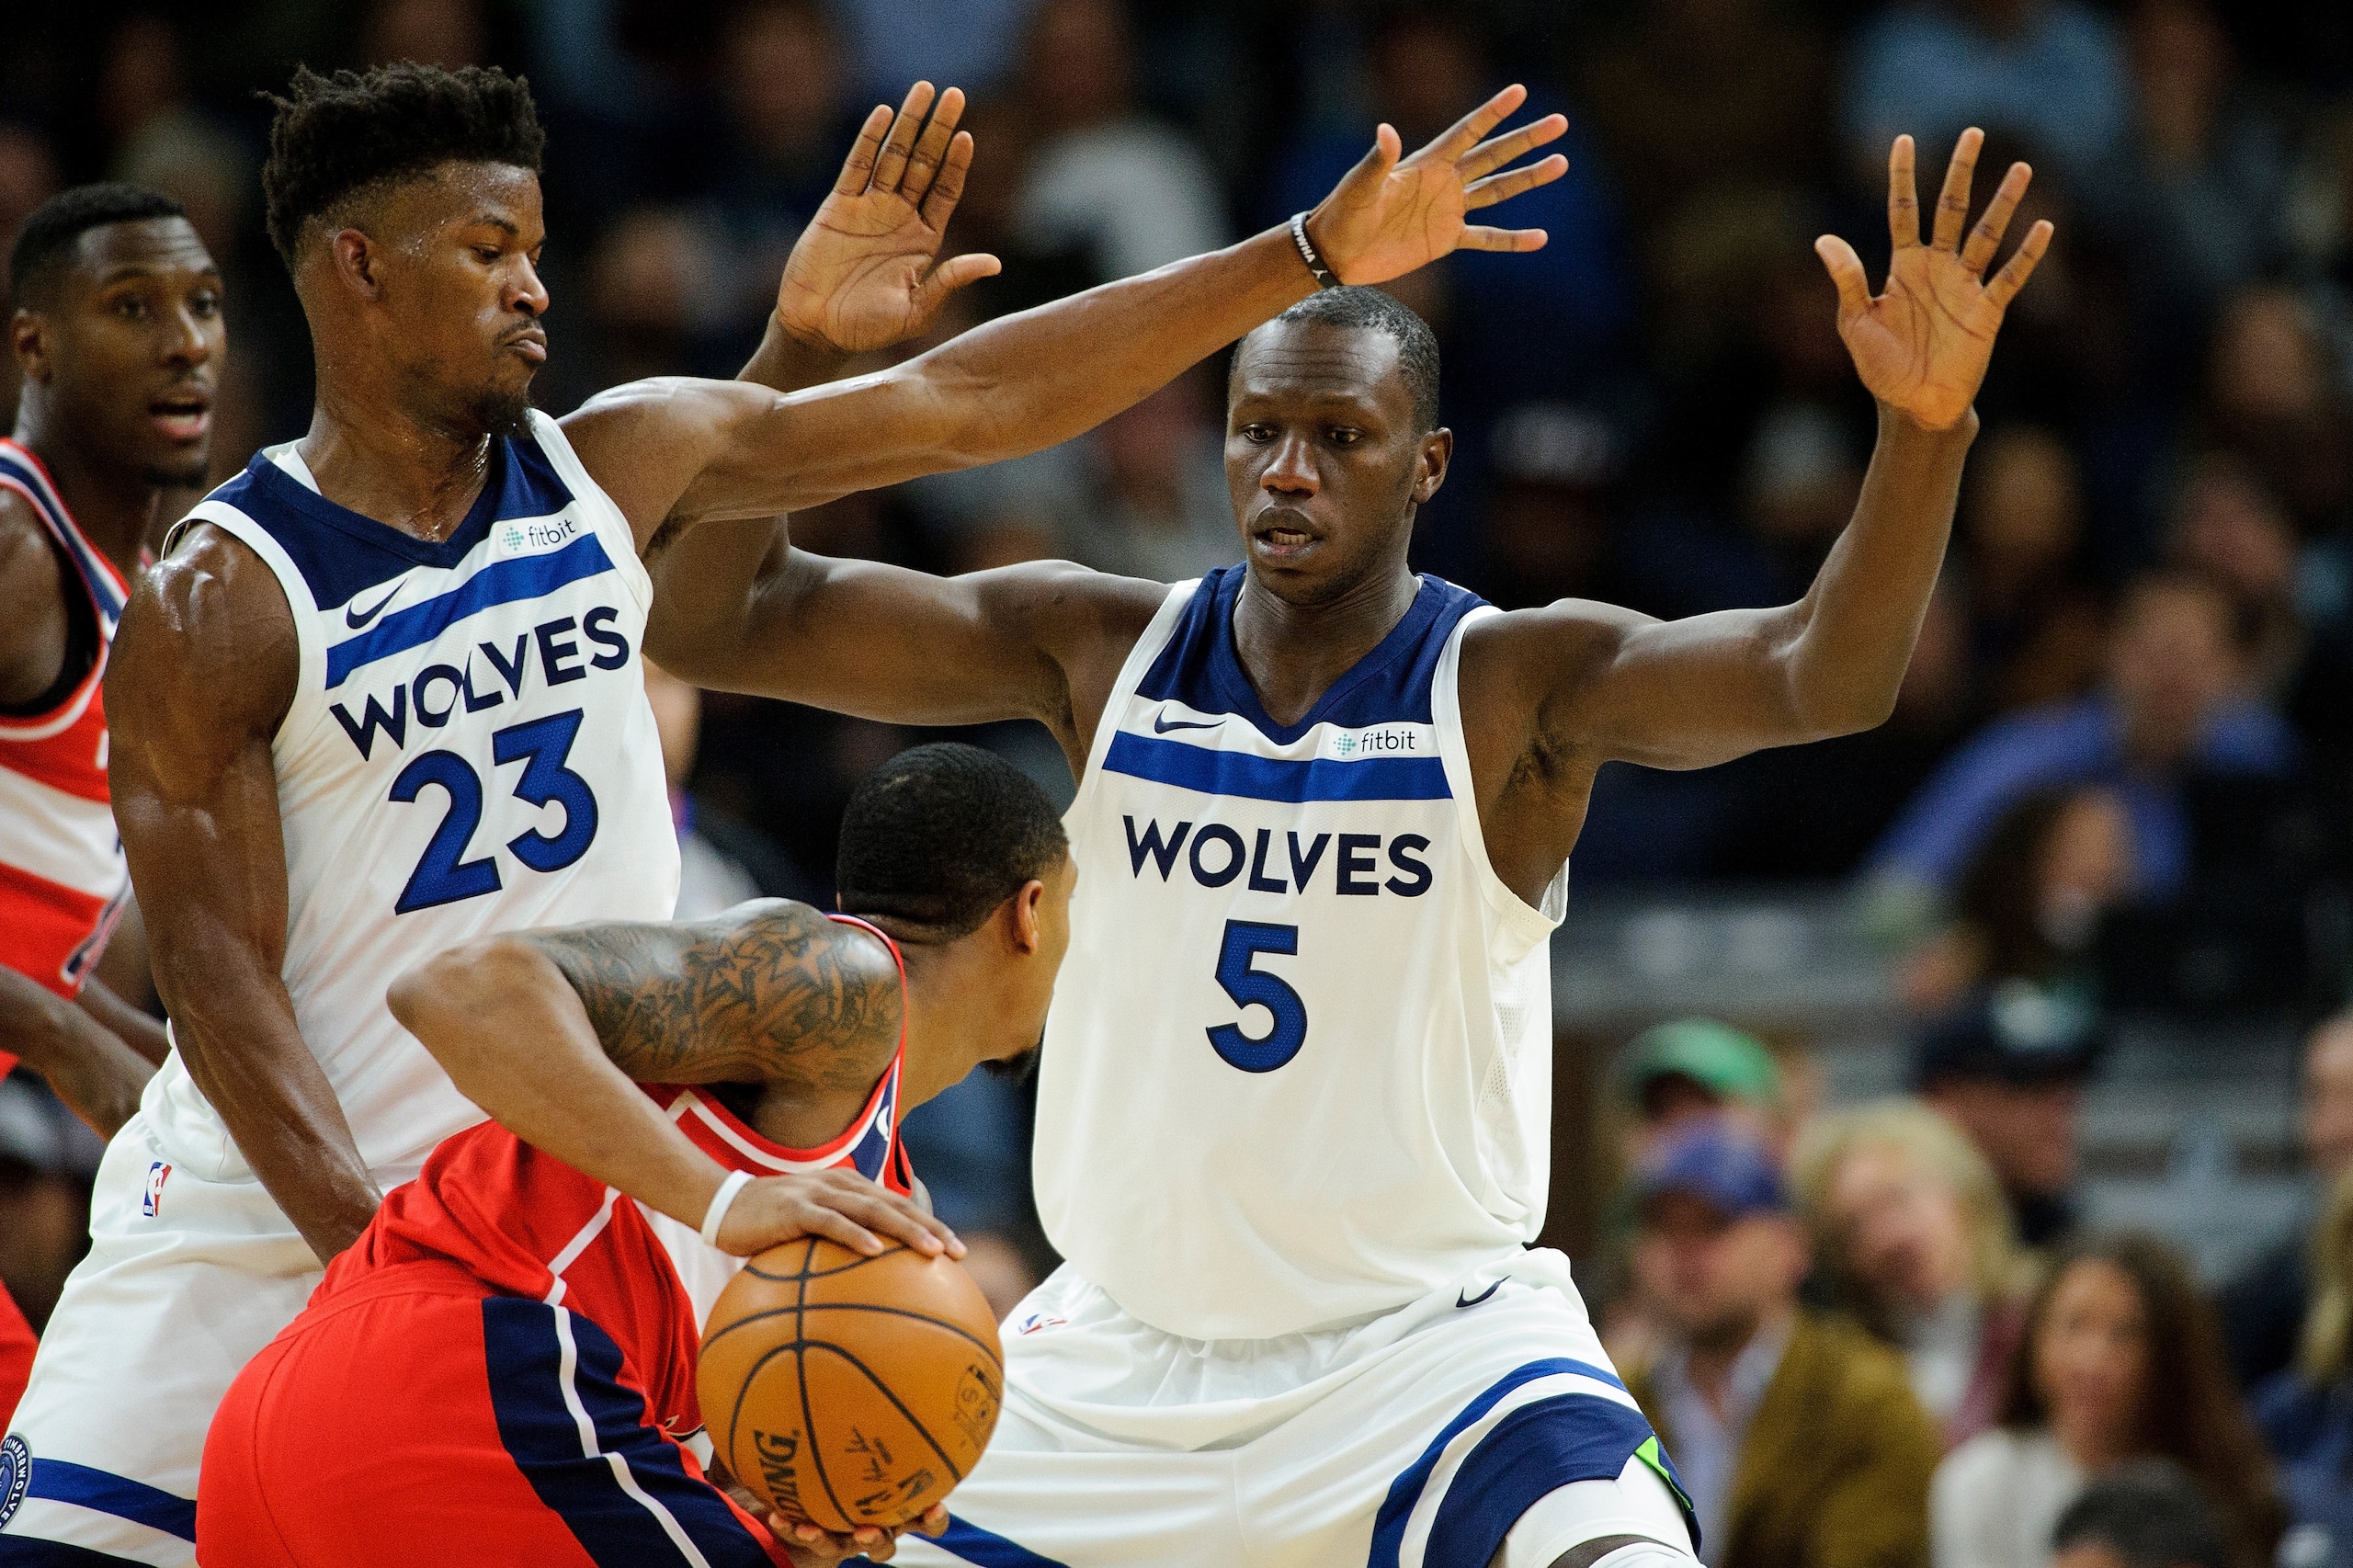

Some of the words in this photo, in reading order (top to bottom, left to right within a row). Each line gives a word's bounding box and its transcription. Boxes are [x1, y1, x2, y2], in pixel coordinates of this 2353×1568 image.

[529, 519, 576, 547] fitbit
[329, 606, 630, 762] WOLVES
[1361, 730, 1415, 753] fitbit
[388, 708, 599, 915] 23
[1122, 814, 1433, 898] WOLVES
[1205, 918, 1308, 1074] 5
